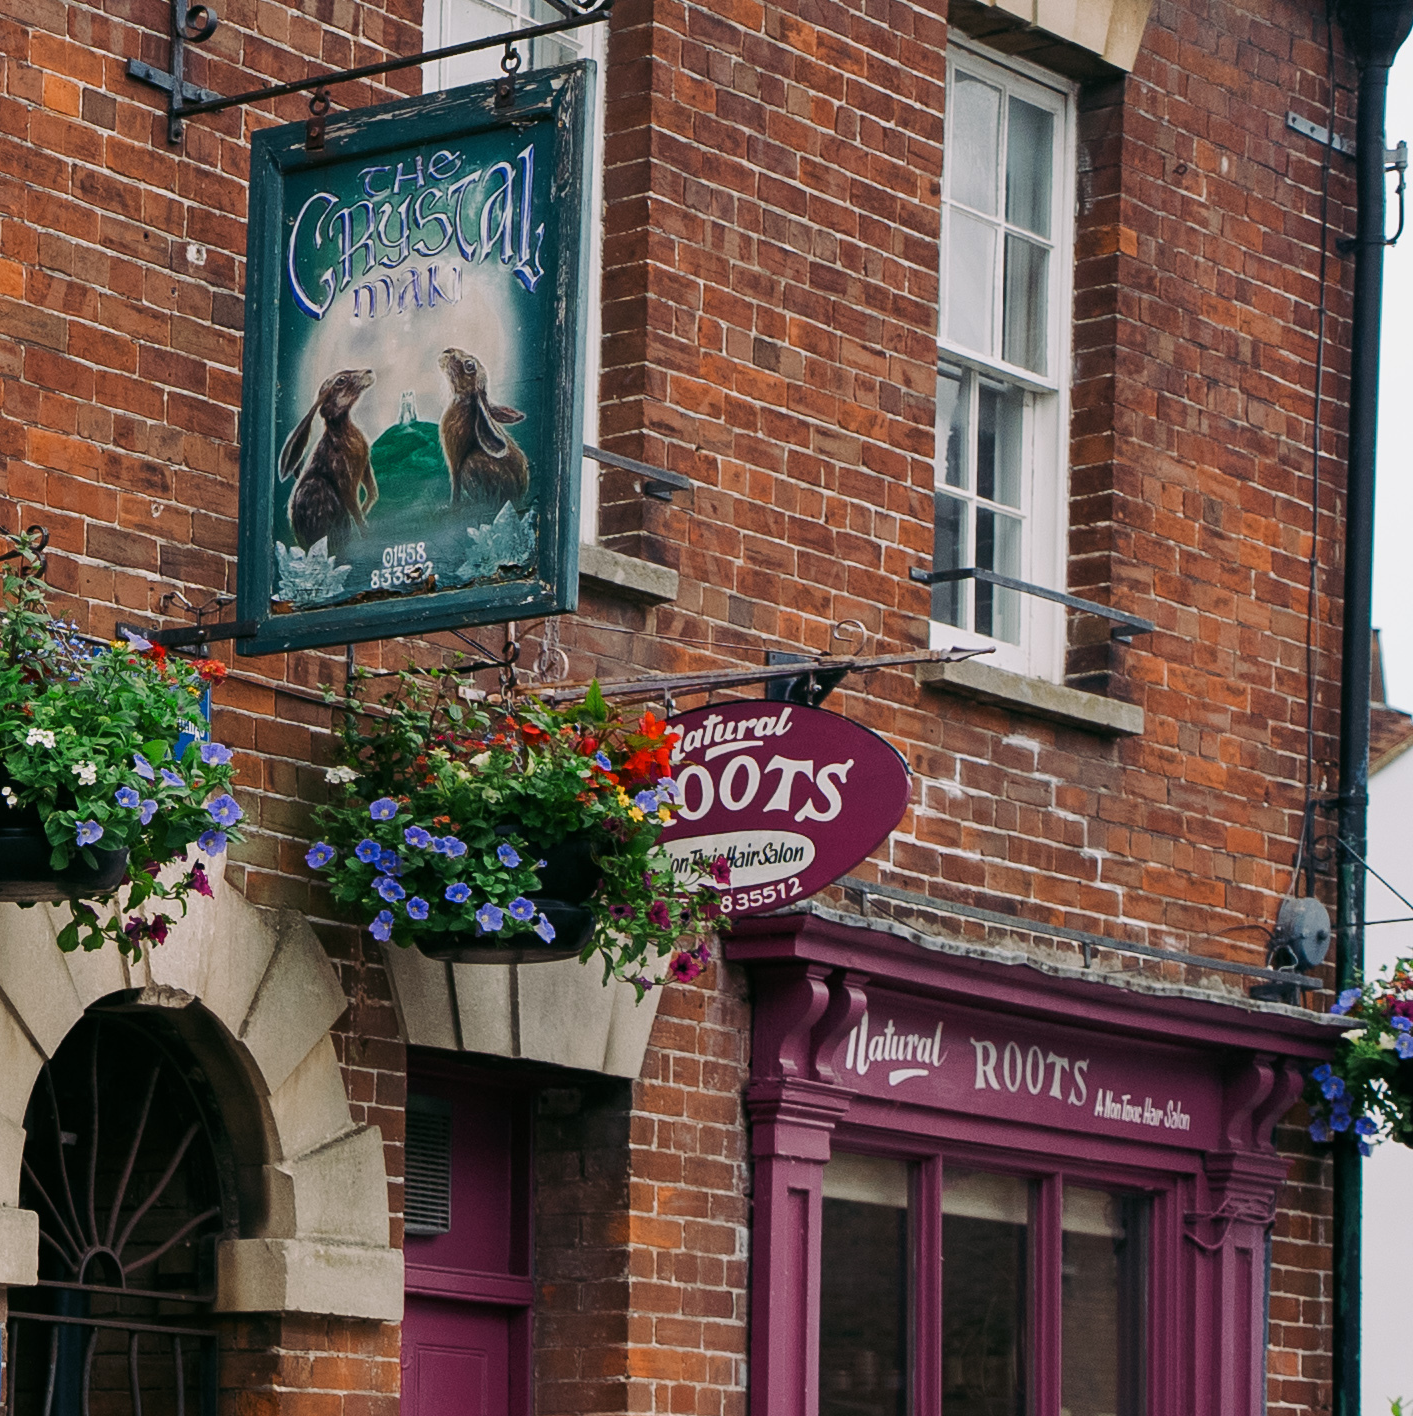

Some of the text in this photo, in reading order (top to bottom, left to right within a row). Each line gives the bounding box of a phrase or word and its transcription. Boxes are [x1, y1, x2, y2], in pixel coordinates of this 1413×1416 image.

[382, 541, 427, 568] 01458
[647, 754, 855, 828] OOTS
[726, 843, 760, 869] Hair
[758, 842, 804, 865] Salon
[845, 1010, 1089, 1107] Natural ROOTS
[1094, 1087, 1191, 1131] A Non Toxic Hair Salon
